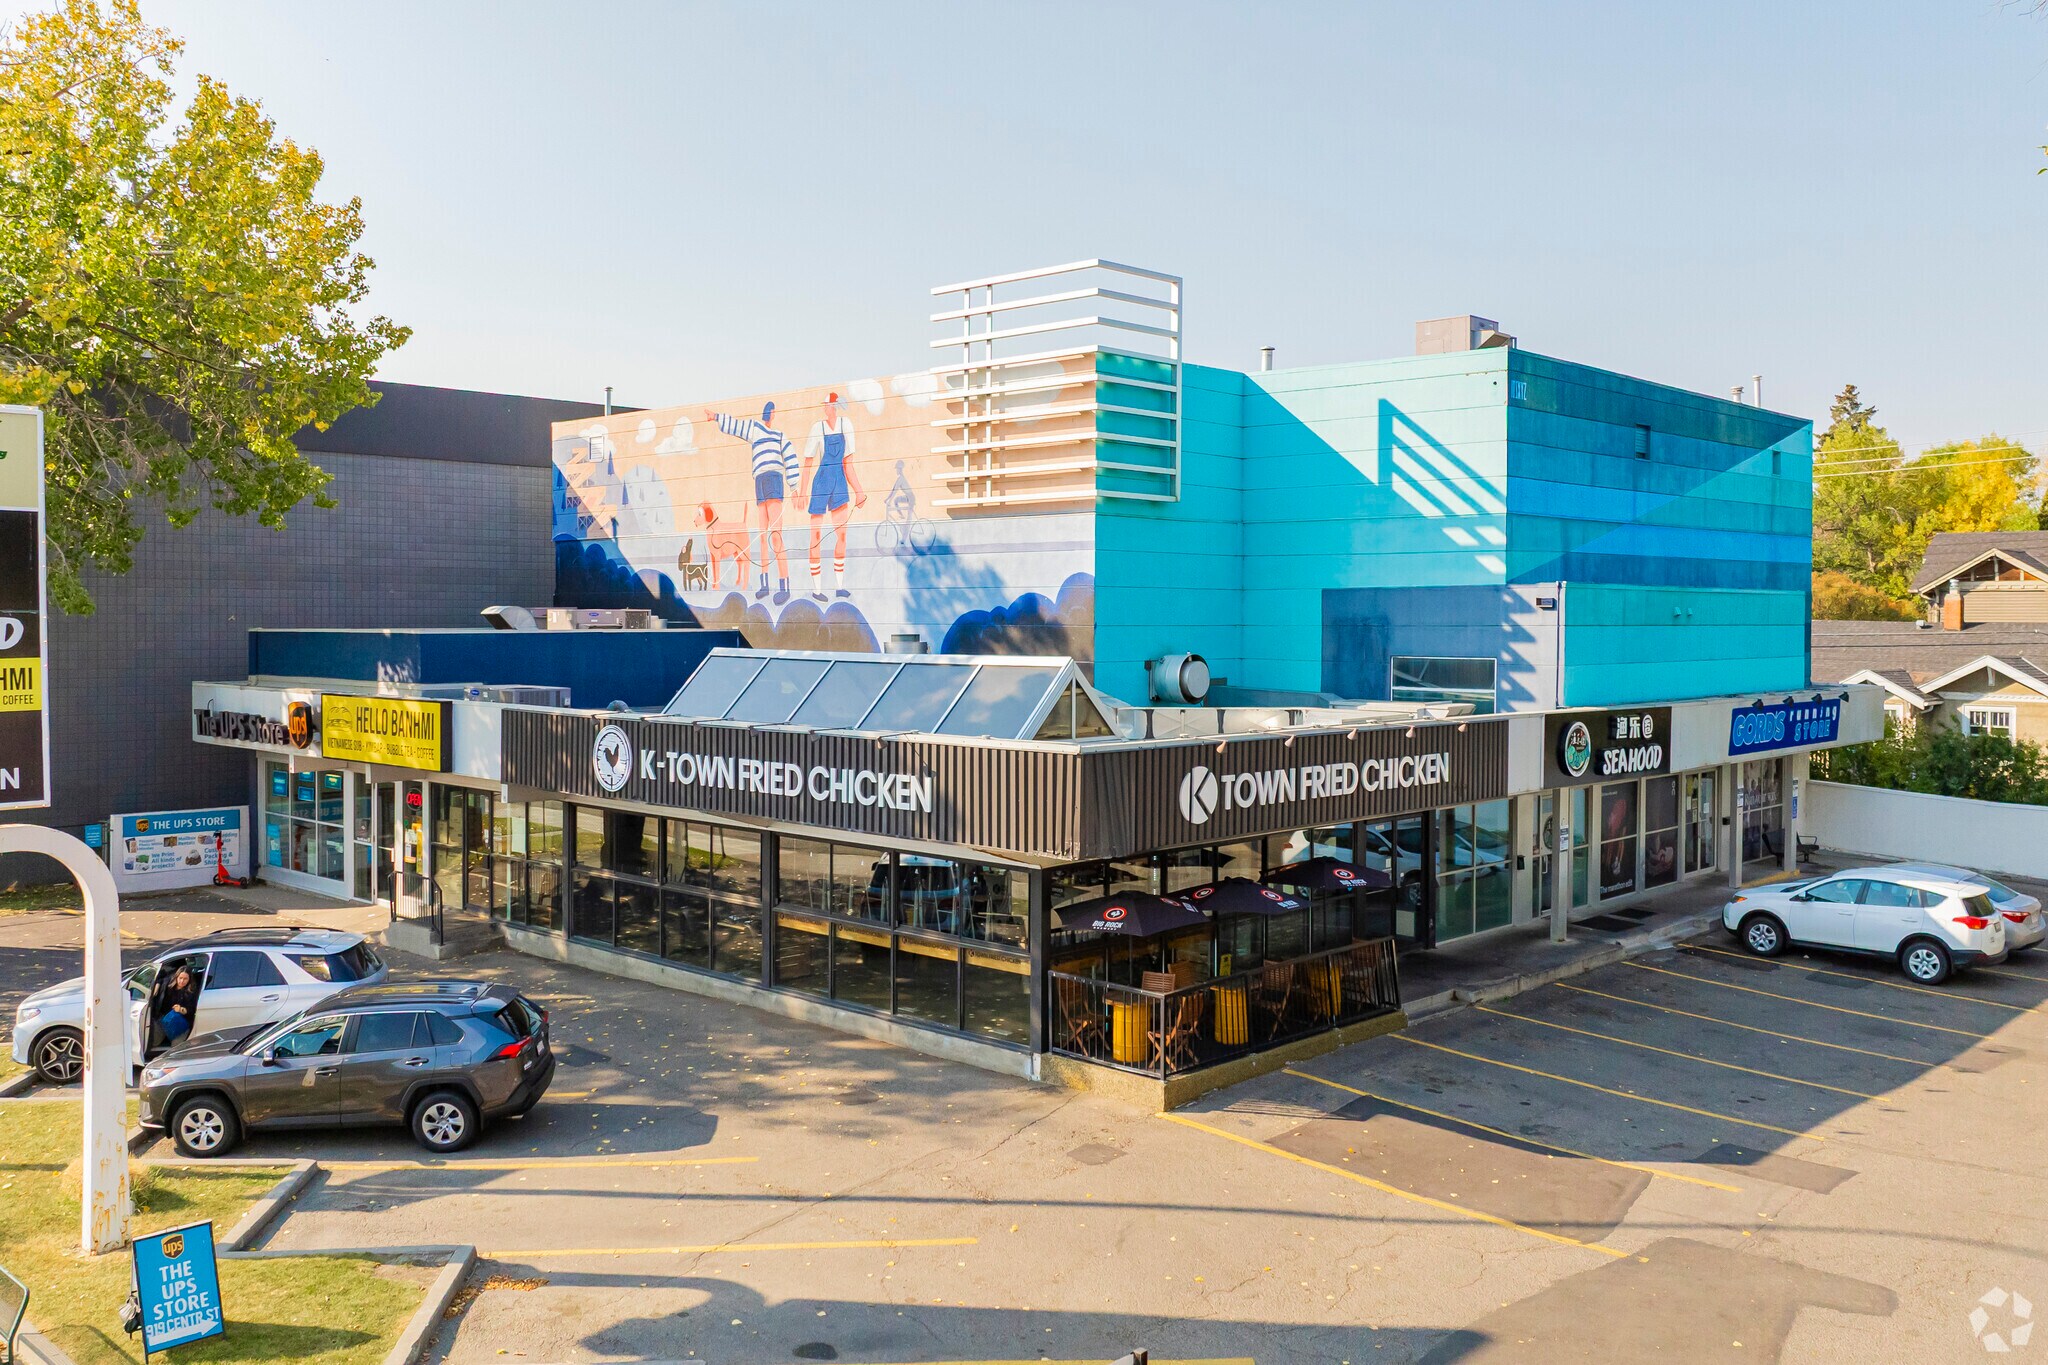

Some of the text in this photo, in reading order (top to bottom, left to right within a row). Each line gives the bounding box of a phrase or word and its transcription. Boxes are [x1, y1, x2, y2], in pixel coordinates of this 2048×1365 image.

[3, 694, 34, 705] COFFEE
[194, 709, 284, 746] The UPS Store
[356, 706, 435, 741] HELLO BANHMI
[1732, 710, 1786, 747] GORD'S
[1794, 719, 1831, 741] STORE
[417, 747, 435, 760] COFFEE
[1603, 745, 1662, 775] SEAHOOD
[640, 749, 933, 813] K-TOWN FRIED CHICKEN
[1221, 768, 1296, 811] TOWN
[1300, 762, 1359, 800] FRIED
[1361, 752, 1449, 792] CHICKEN
[153, 820, 170, 830] THE
[173, 818, 193, 829] UPS
[196, 816, 225, 827] STORE
[163, 1240, 183, 1256] ups
[159, 1260, 193, 1282] THE
[161, 1277, 197, 1300] UPS
[153, 1291, 210, 1321] STORE
[145, 1322, 166, 1337] 919
[206, 1307, 220, 1322] ST
